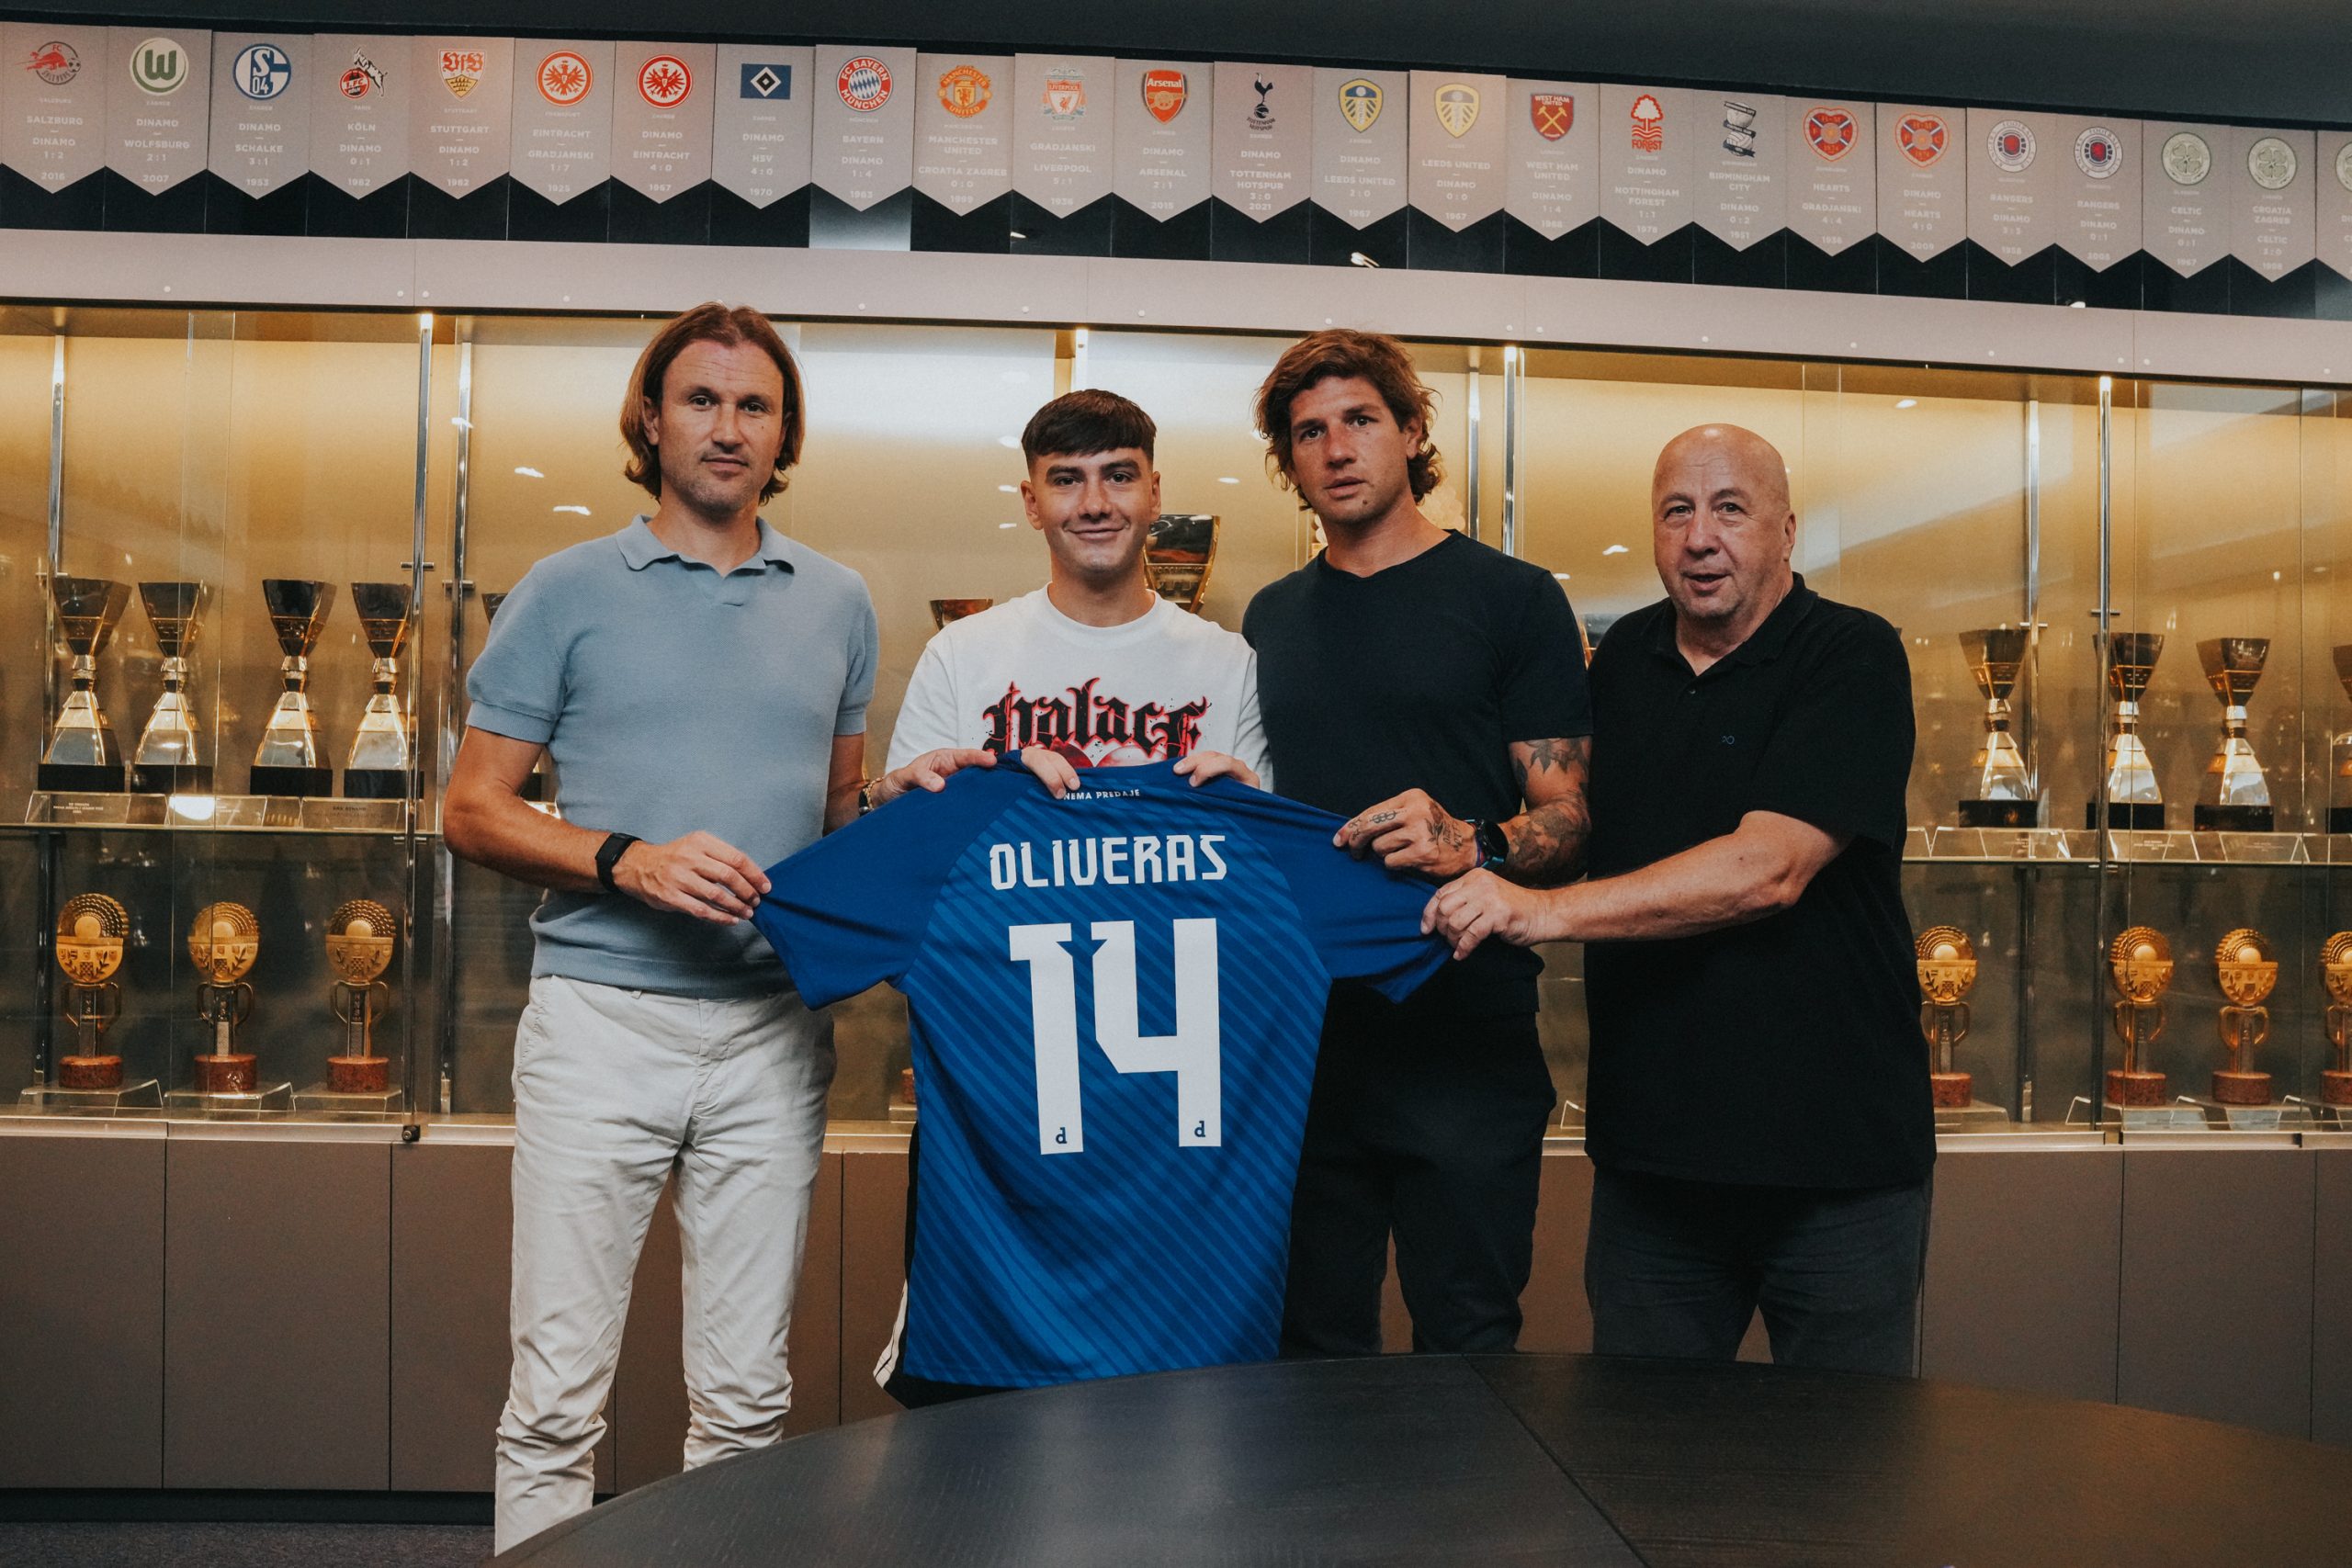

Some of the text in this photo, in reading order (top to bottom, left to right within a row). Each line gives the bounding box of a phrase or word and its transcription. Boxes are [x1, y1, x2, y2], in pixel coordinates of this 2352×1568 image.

[842, 60, 889, 81] FC BAYERN
[1148, 78, 1182, 88] Arsenal
[949, 104, 980, 116] UNITED
[27, 116, 83, 125] SALZBURG
[137, 118, 178, 127] DINAMO
[239, 123, 281, 131] DINAMO
[348, 122, 376, 131] KÖLN
[533, 130, 590, 138] EINTRACHT
[642, 130, 683, 139] DINAMO
[742, 133, 784, 141] DINAMO
[33, 138, 75, 146] DINAMO
[929, 137, 998, 145] MANCHESTER
[235, 144, 282, 152] SCHALKE
[340, 144, 381, 152] DINAMO
[528, 151, 594, 159] GRADJANSKI
[1241, 151, 1281, 159] DINAMO
[919, 166, 963, 175] CROATIA
[1034, 164, 1091, 173] LIVERPOOL
[1526, 162, 1553, 170] WEST
[1139, 168, 1186, 176] ARSENAL
[1230, 170, 1291, 178] TOTTENHAM
[1627, 167, 1667, 175] DINAMO
[1325, 175, 1396, 186] LEEDS UNITED
[1534, 172, 1569, 180] UNITED
[1709, 173, 1770, 182] BIRMINGHAM
[1437, 180, 1476, 188] DINAMO
[1729, 183, 1750, 191] CITY
[1814, 184, 1849, 192] HEARTS
[1532, 192, 1572, 200] DINAMO
[1615, 187, 1679, 197] NOTTINGHAM
[1904, 189, 1940, 198] DINAMO
[1629, 197, 1665, 206] FOREST
[1990, 194, 2032, 203] RANGERS
[1721, 203, 1758, 211] DINAMO
[1803, 203, 1861, 213] GRADJANSKI
[2077, 200, 2120, 209] RANGERS
[1905, 209, 1940, 219] HEARTS
[2171, 207, 2201, 215] CELTIC
[2253, 206, 2291, 215] CROATIA
[1993, 214, 2030, 222] DINAMO
[2255, 215, 2290, 224] ZAGREB
[2080, 220, 2117, 229] DINAMO
[2168, 226, 2205, 234] DINAMO
[2257, 235, 2287, 244] CELTIC
[1063, 788, 1140, 801] NEMA PREDAJE
[989, 834, 1227, 891] OLIVERAS
[1009, 918, 1221, 1155] 14
